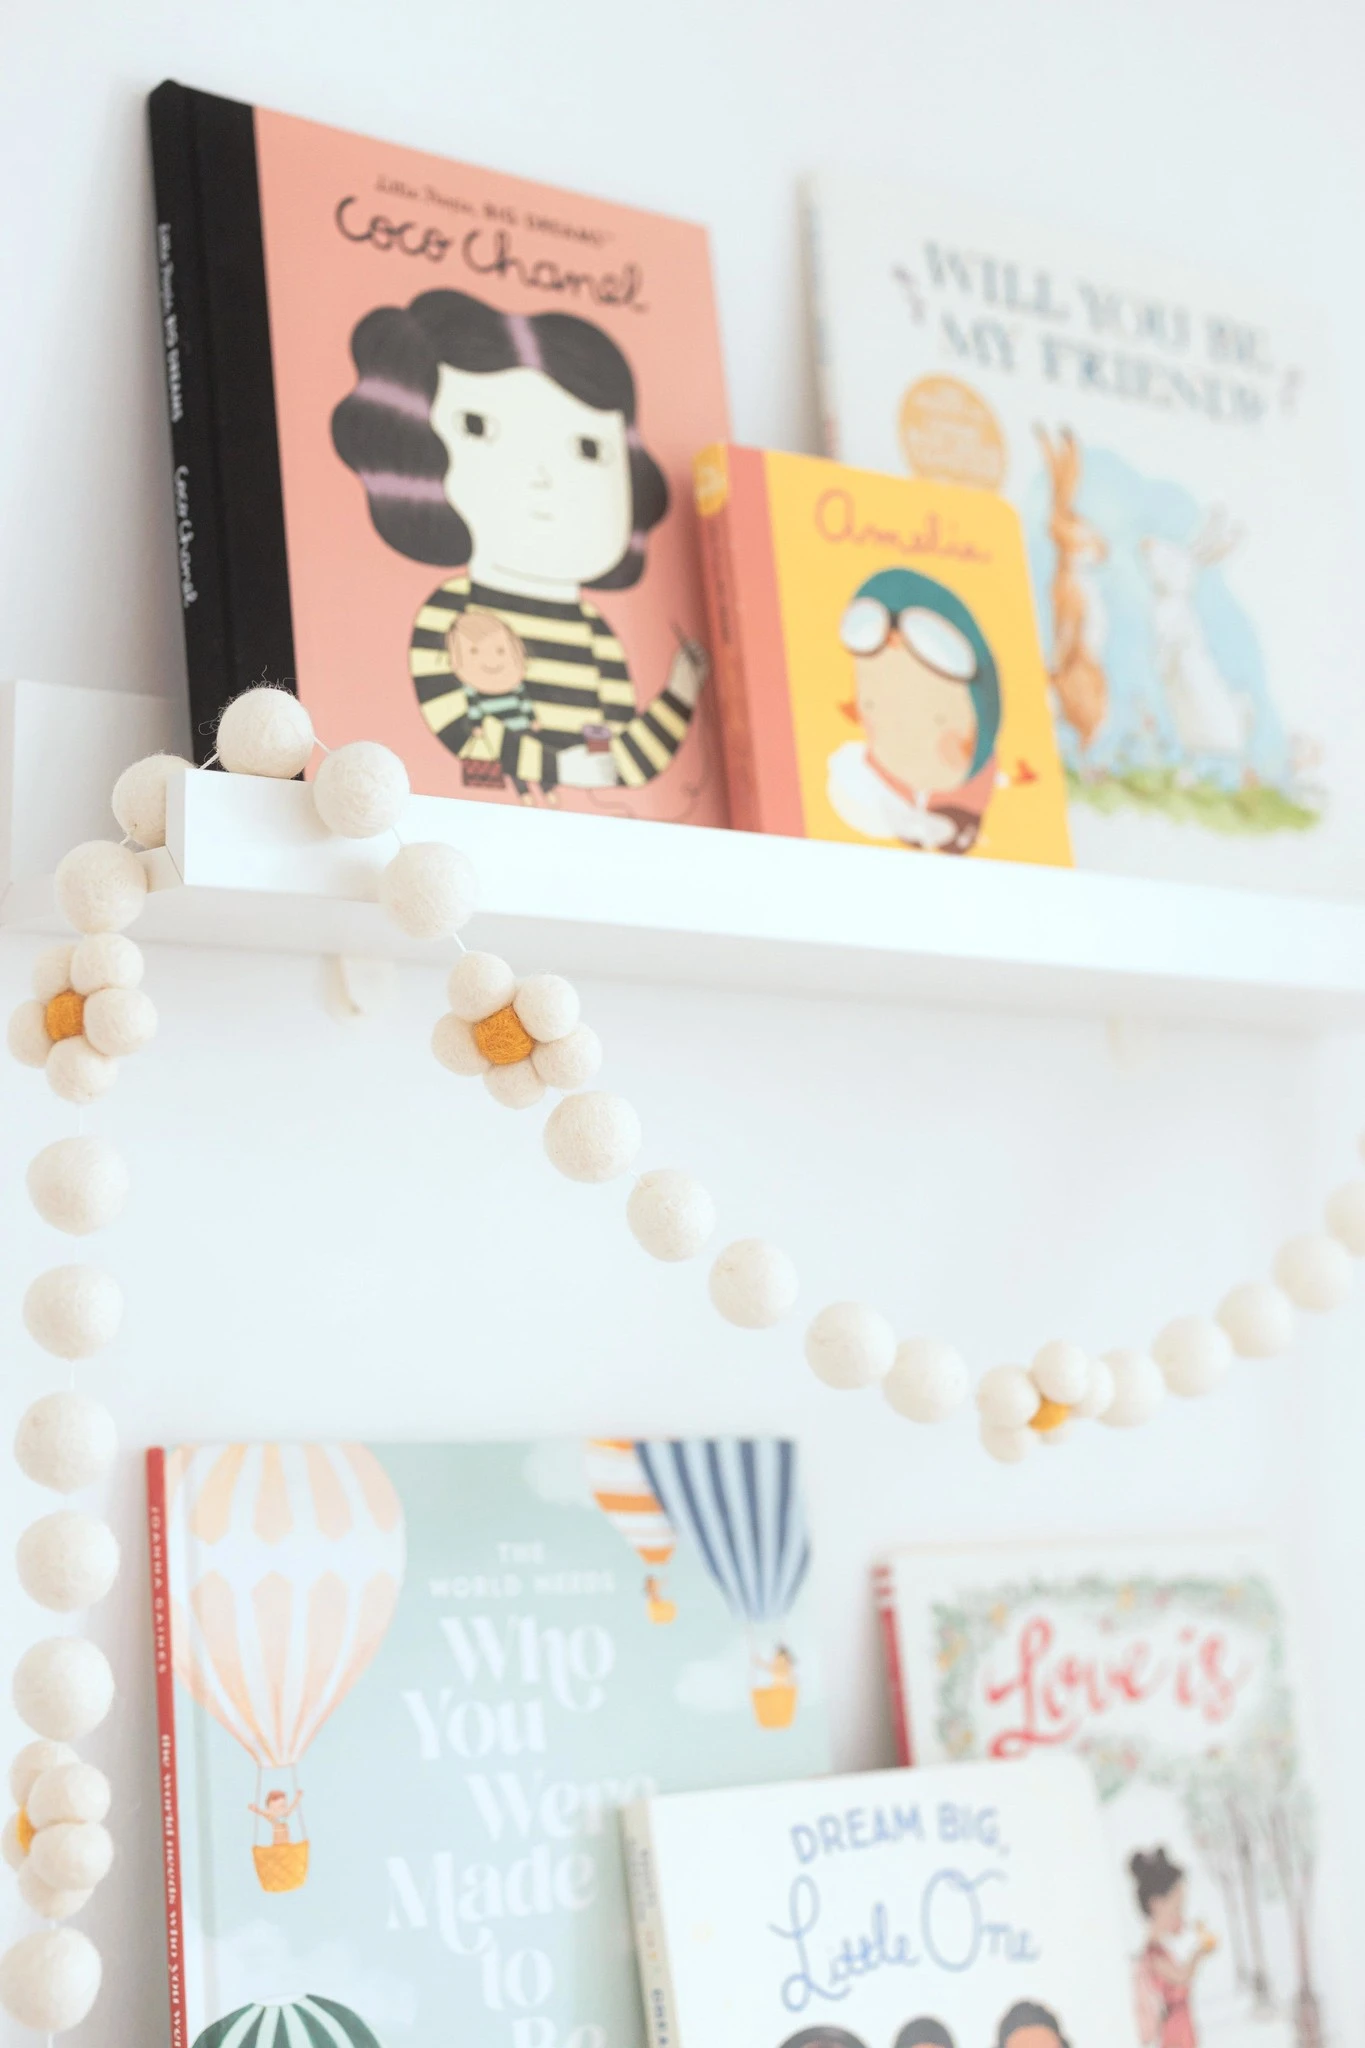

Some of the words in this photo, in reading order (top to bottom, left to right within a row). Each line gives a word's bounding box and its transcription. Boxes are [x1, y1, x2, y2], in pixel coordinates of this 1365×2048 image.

[334, 195, 454, 262] Coco
[461, 227, 648, 314] Chanel
[922, 240, 1069, 322] WILL
[1076, 278, 1192, 354] YOU
[938, 310, 1020, 374] MY
[175, 465, 189, 518] Coco
[814, 487, 994, 563] Amelia
[179, 519, 198, 608] Chanel
[151, 1506, 163, 1590] JOANNA
[497, 1541, 545, 1564] THE
[429, 1574, 523, 1599] WORLD
[533, 1569, 617, 1596] NEEDS
[155, 1597, 167, 1673] GAINES
[440, 1614, 617, 1713] Who
[984, 1614, 1175, 1760] Love
[1177, 1626, 1255, 1724] is
[161, 1734, 172, 1768] the
[402, 1687, 547, 1761] You
[163, 1773, 176, 1836] world
[790, 1804, 925, 1865] DREAM
[936, 1801, 1010, 1855] BIG,
[166, 1840, 177, 1905] needs
[386, 1843, 600, 1956] Made
[169, 1911, 179, 1959] who
[767, 1873, 922, 2012] Little
[920, 1867, 1042, 1974] One
[168, 1963, 181, 2005] you
[481, 1944, 555, 2012] to
